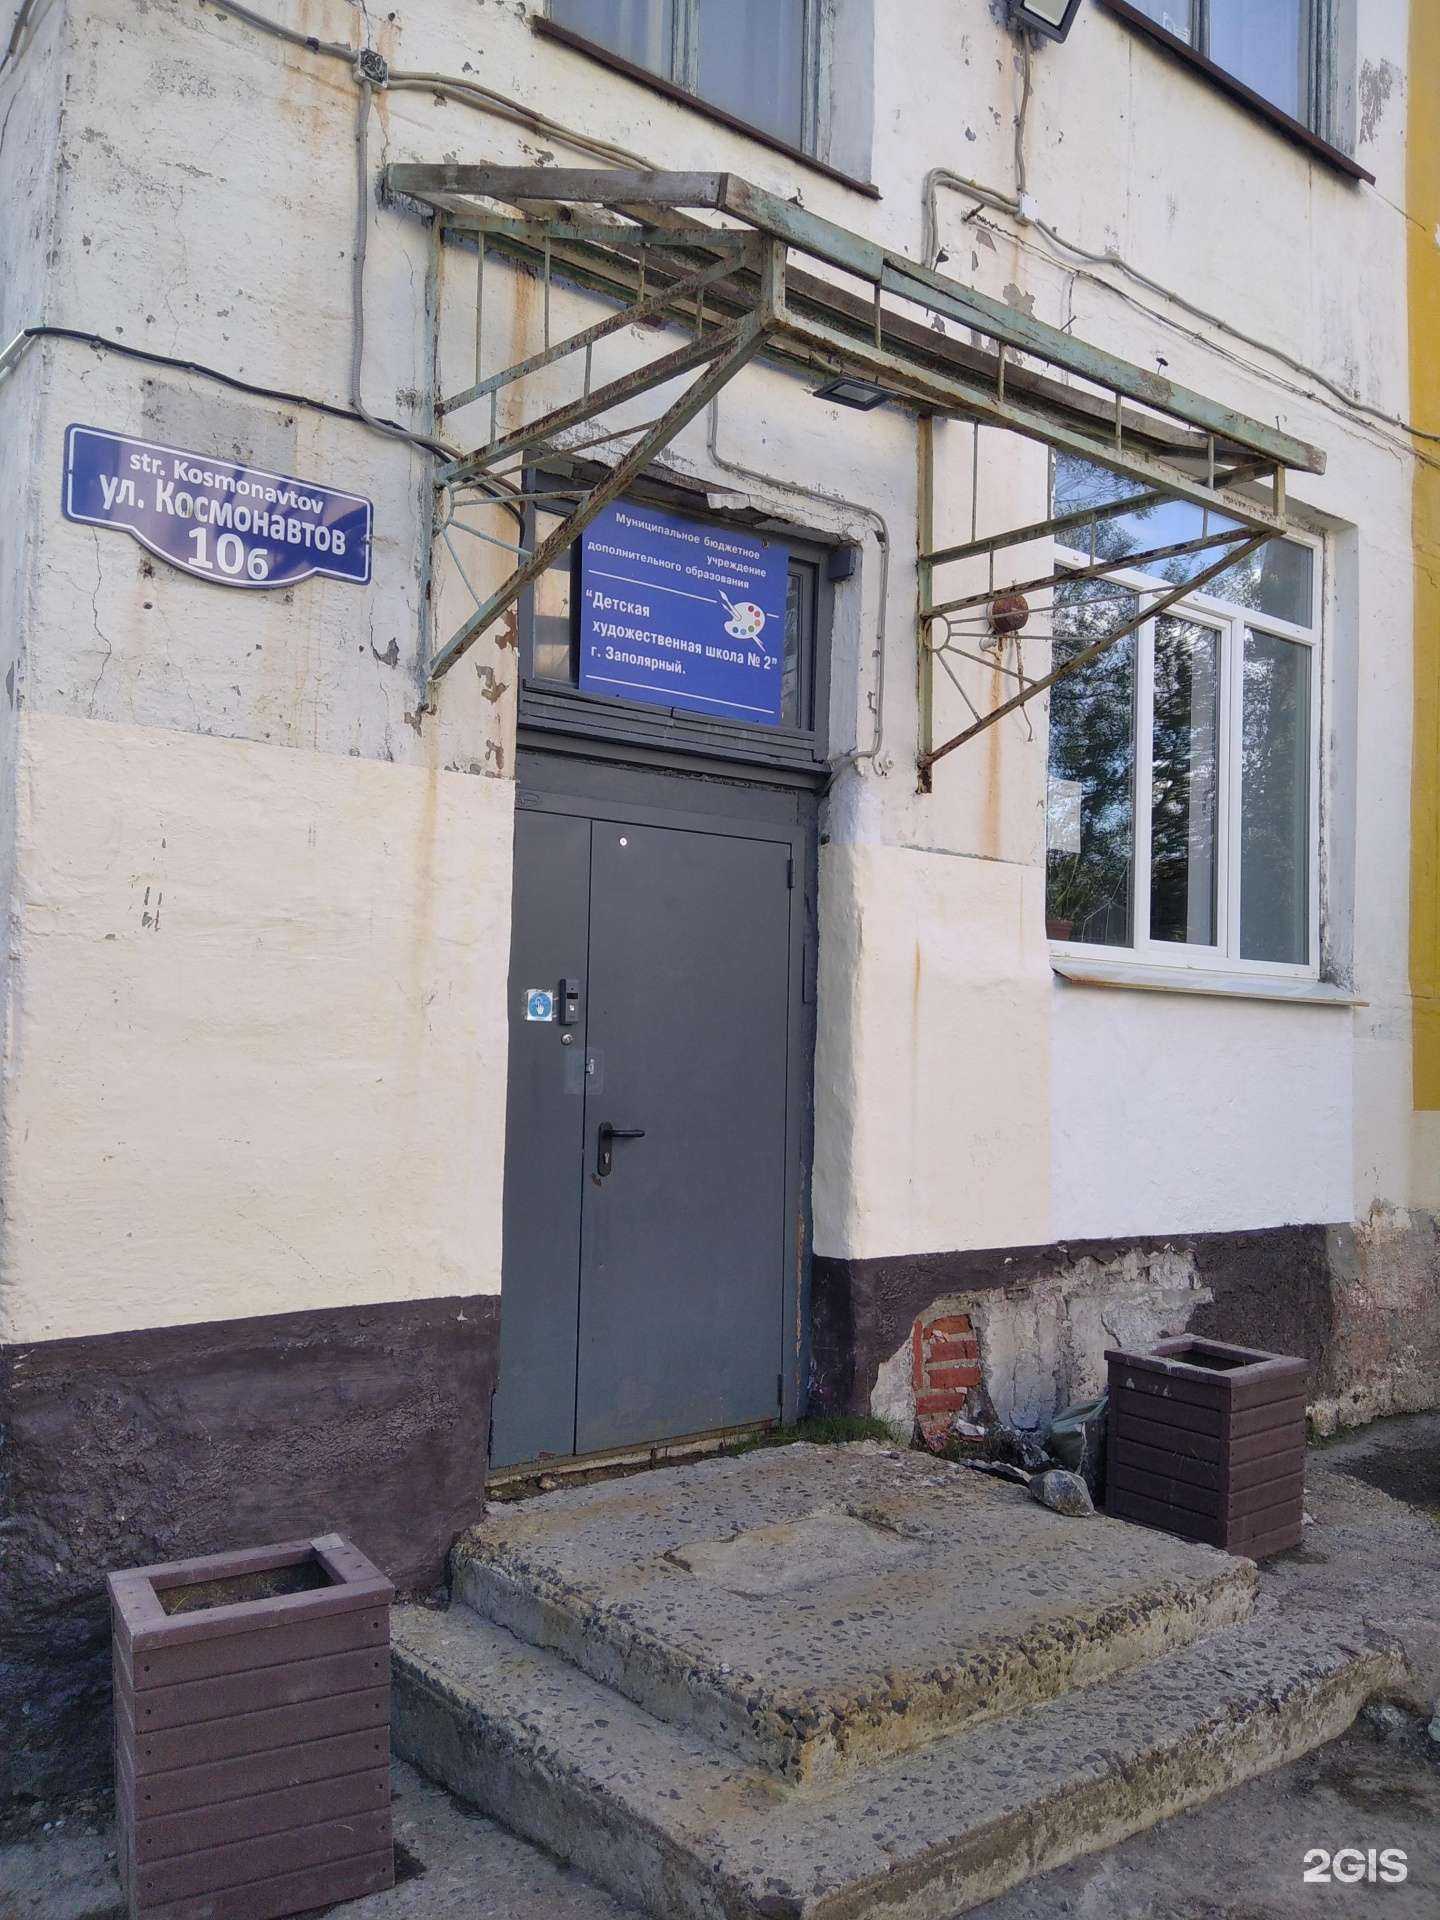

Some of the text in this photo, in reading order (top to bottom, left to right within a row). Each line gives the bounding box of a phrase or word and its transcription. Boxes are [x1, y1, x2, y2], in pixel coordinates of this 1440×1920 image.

[130, 452, 324, 514] str. Kosmonavtov
[99, 474, 347, 556] ул. Космонавтов
[615, 512, 760, 560] Муниципальное бюджетное
[587, 541, 750, 590] дополнительного образования
[706, 554, 767, 578] учреждение
[590, 646, 687, 675] г. Заполярный.
[592, 620, 702, 655] художественная
[705, 644, 744, 664] школа
[747, 651, 761, 668] №
